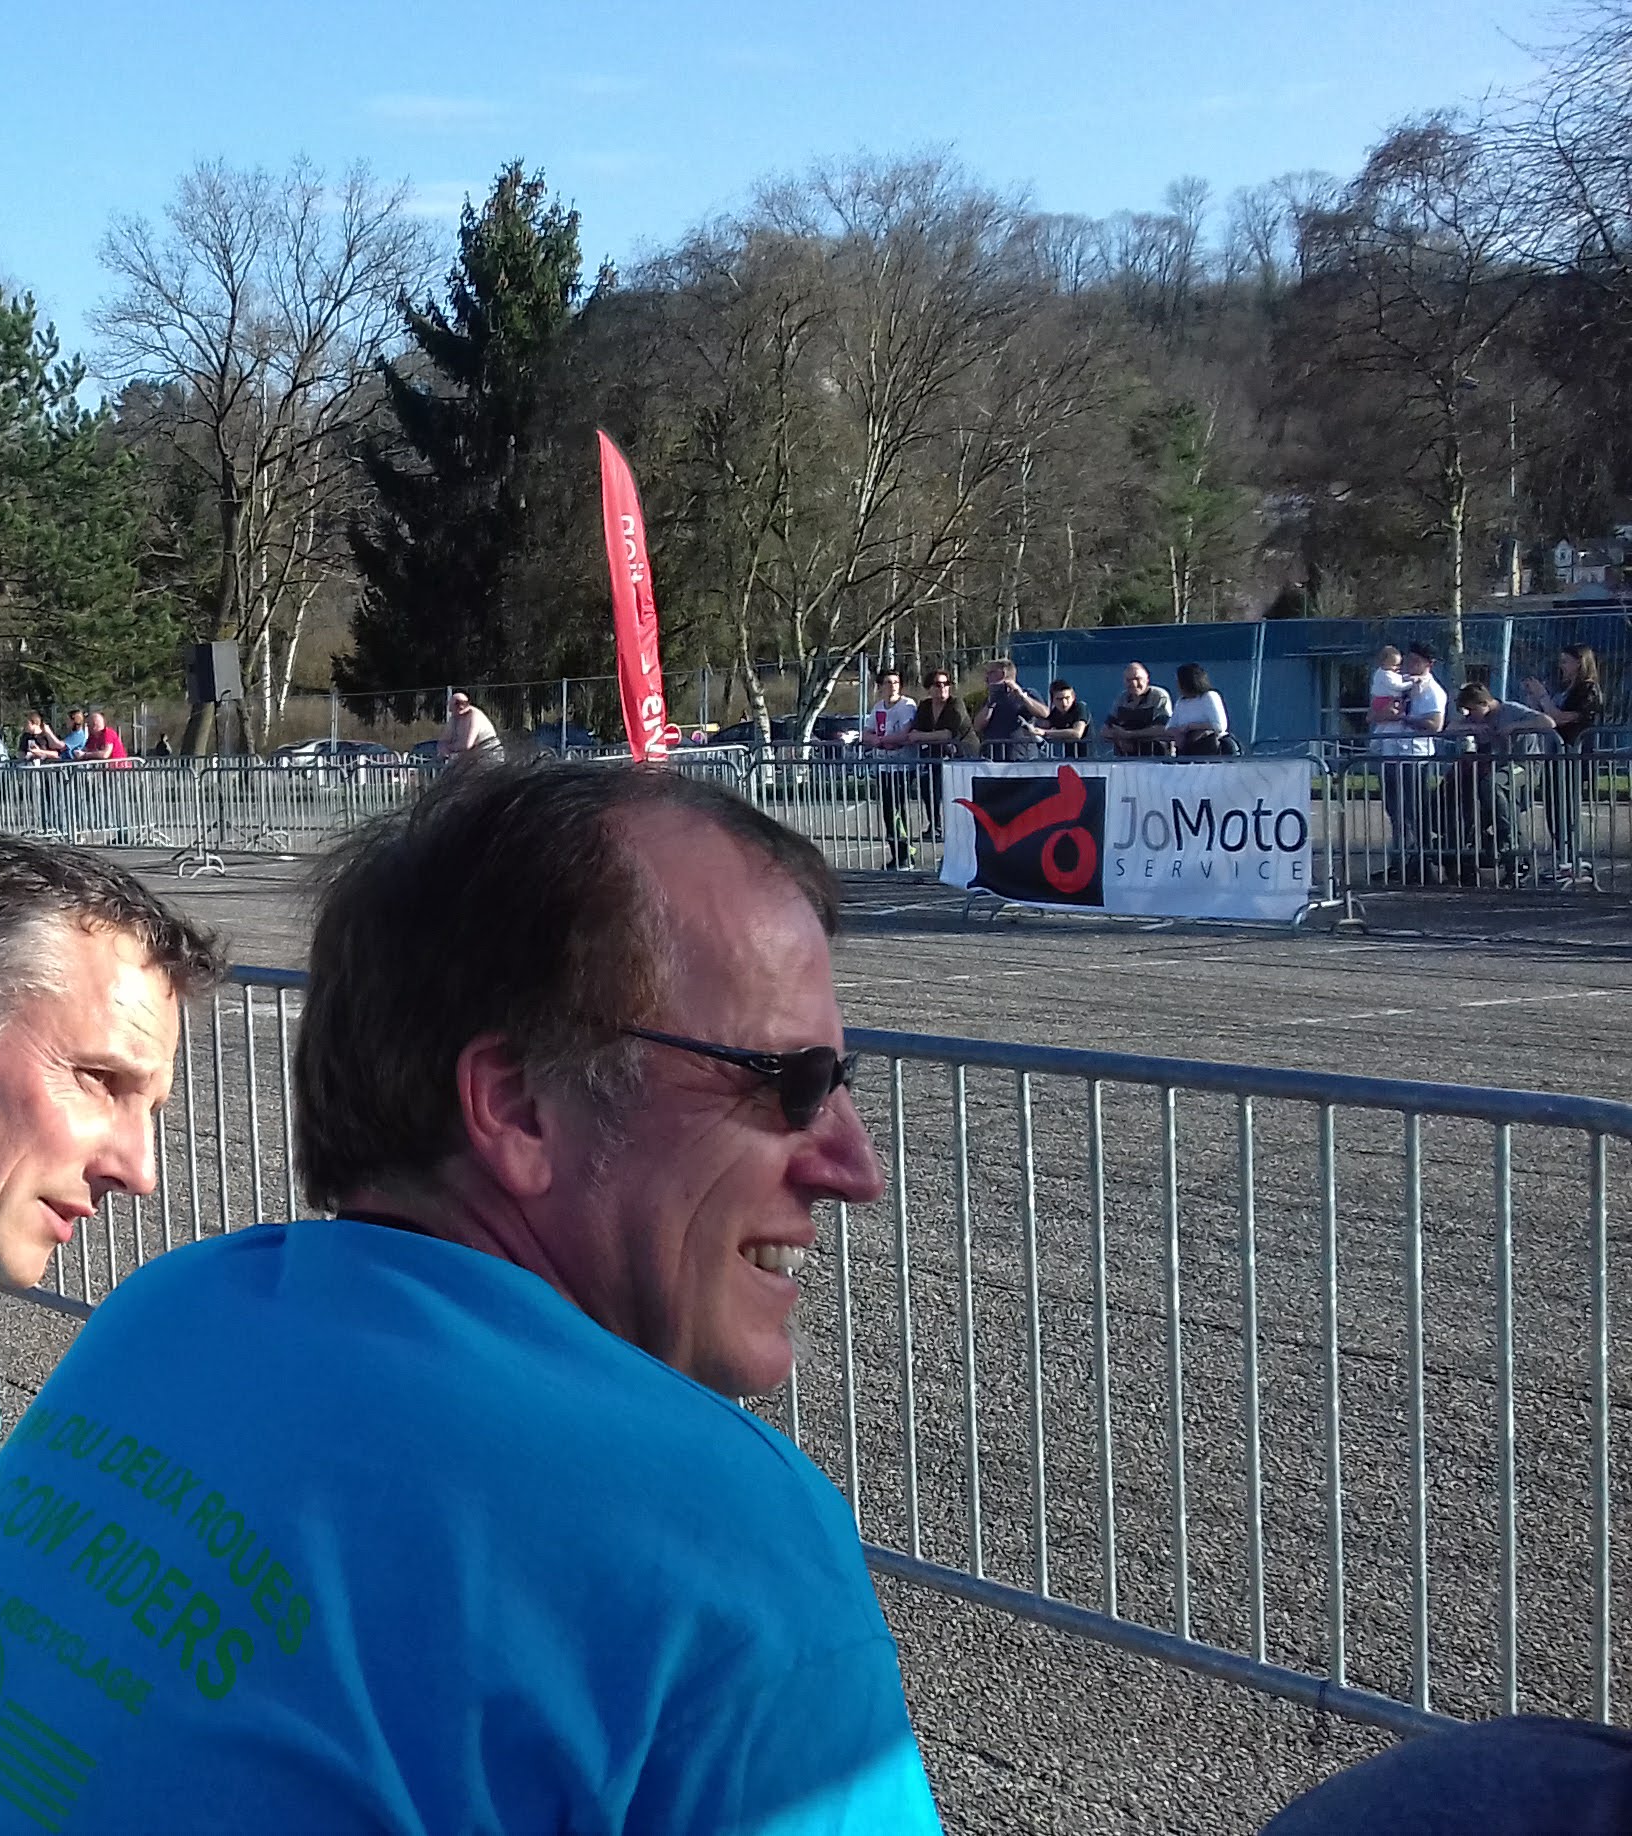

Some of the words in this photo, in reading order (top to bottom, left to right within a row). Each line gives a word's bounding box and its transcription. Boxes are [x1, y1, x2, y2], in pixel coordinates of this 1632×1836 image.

[1113, 796, 1308, 852] JoMoto
[1115, 857, 1304, 880] SERVICE
[47, 1413, 111, 1459] DU
[98, 1434, 204, 1518] DEUX
[184, 1489, 311, 1656] ROUES
[70, 1521, 255, 1700] RIDERS
